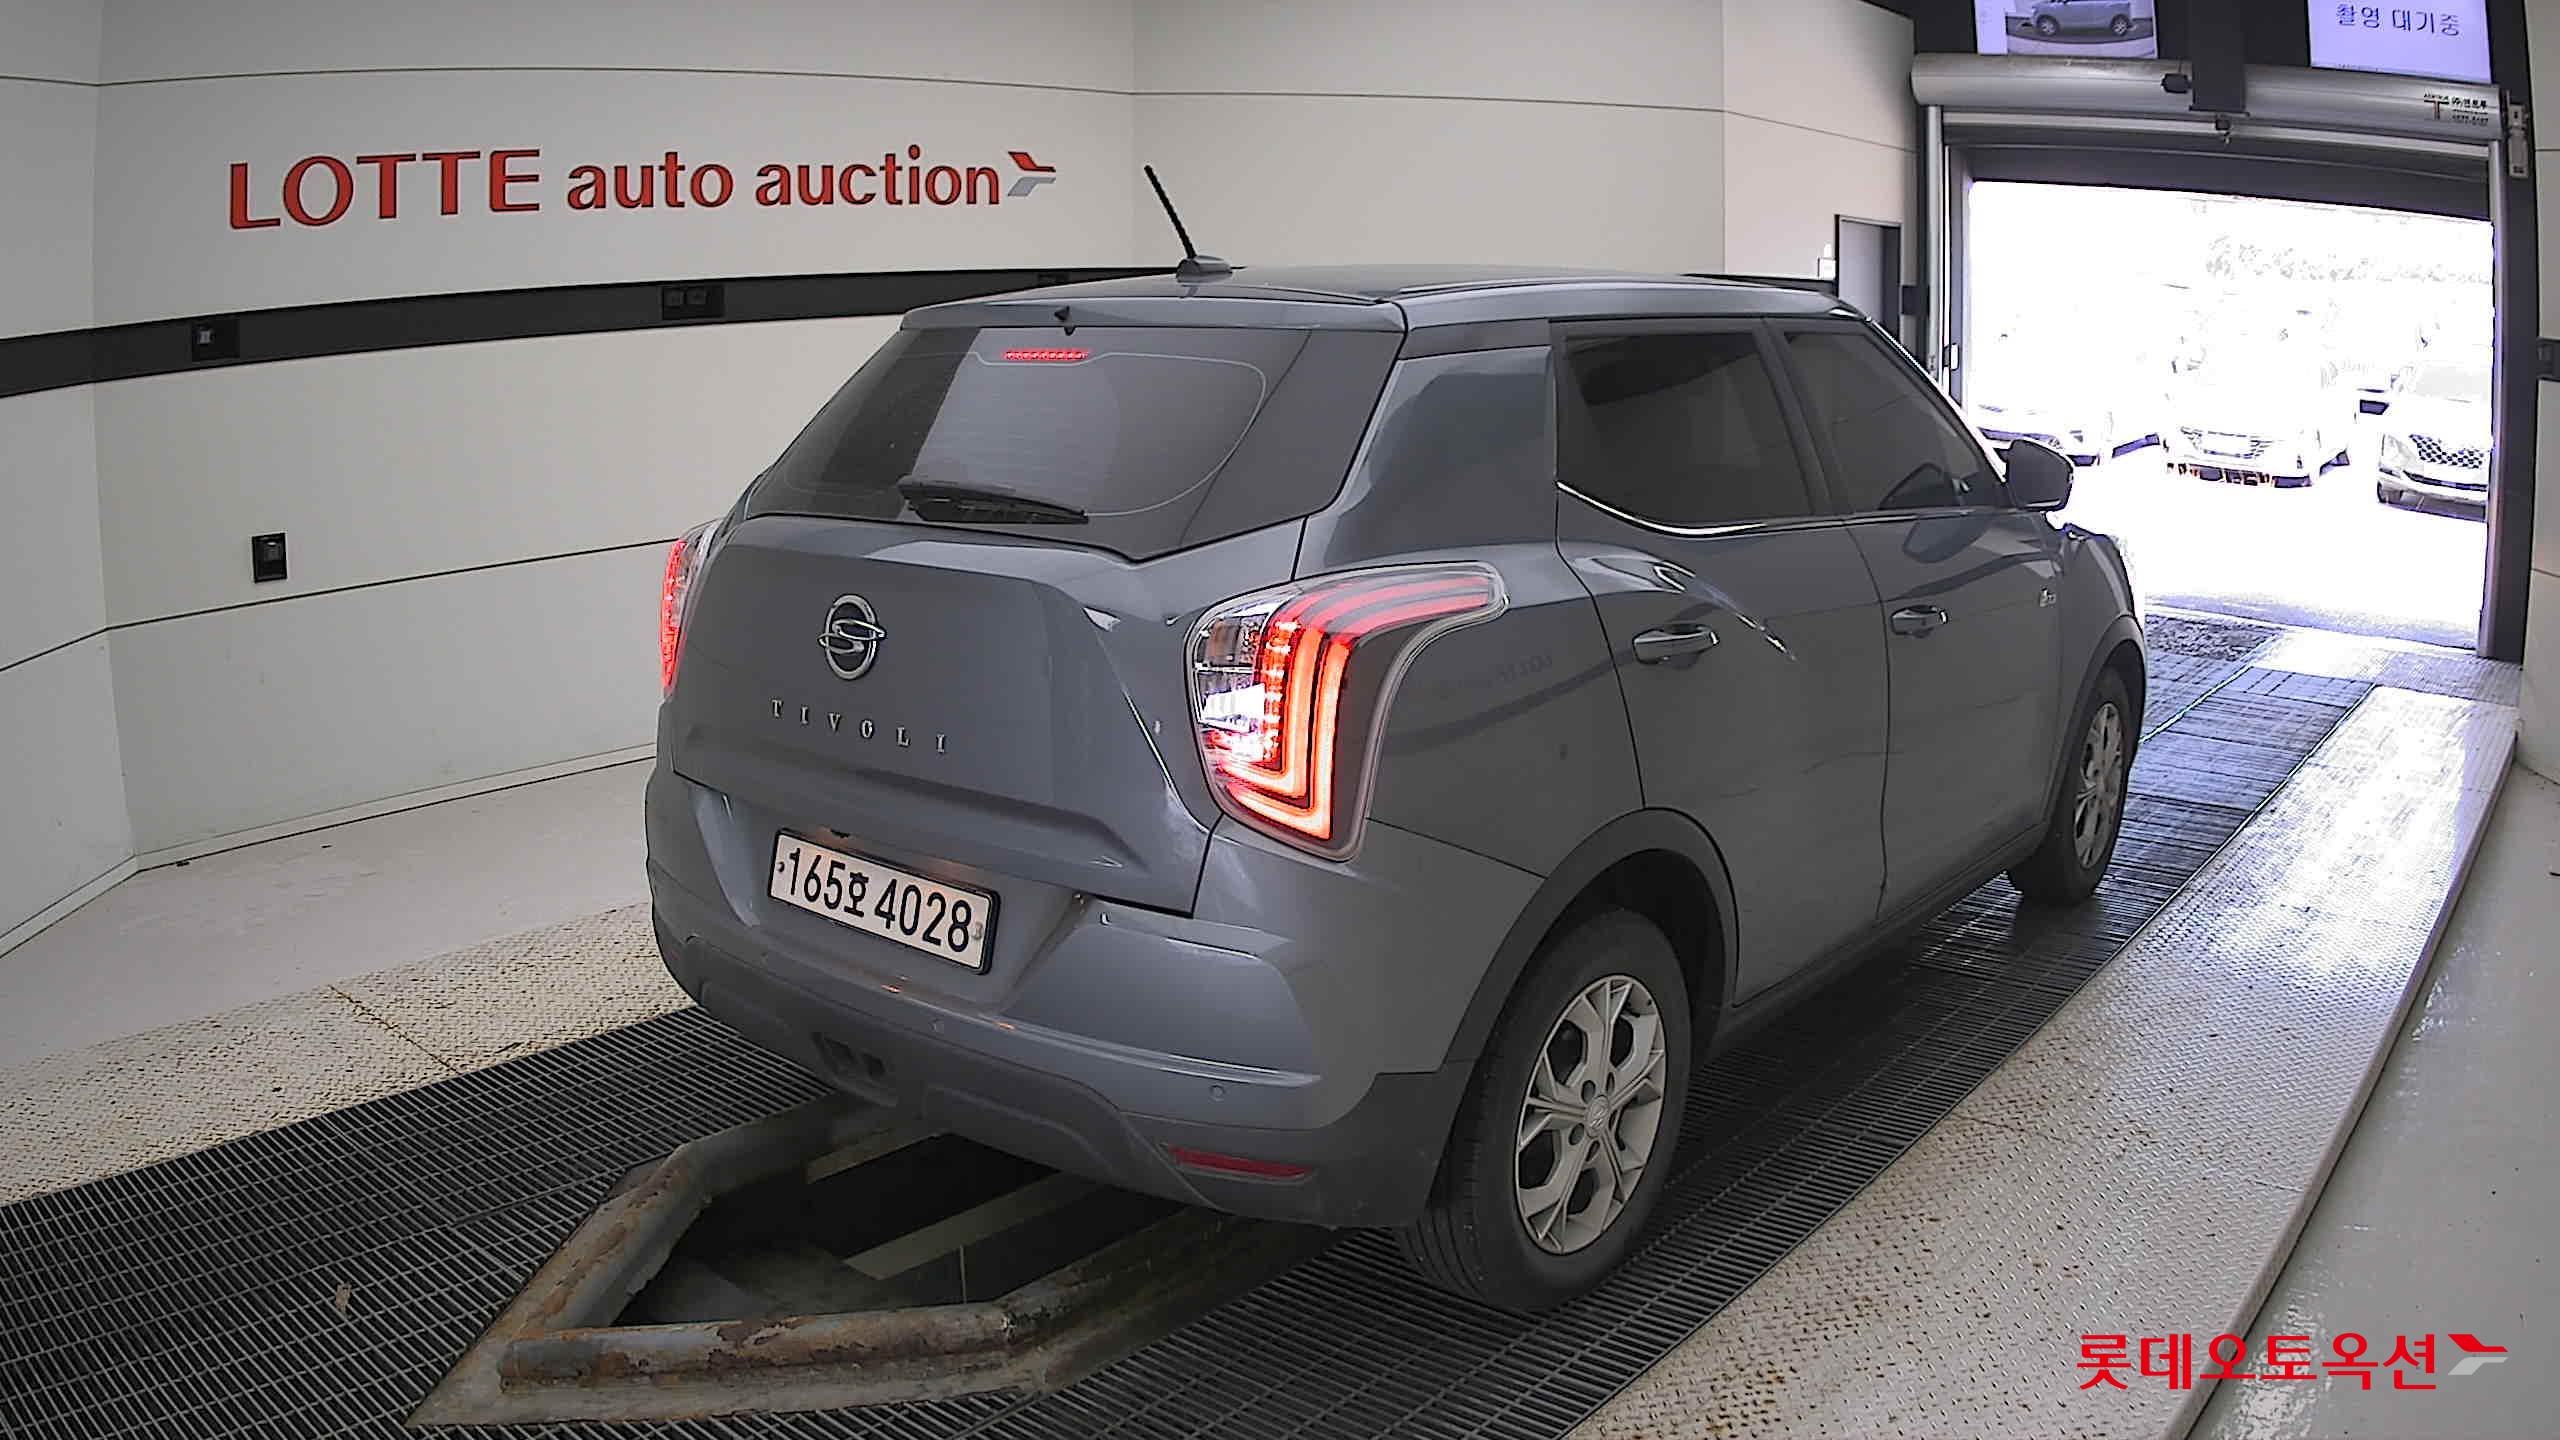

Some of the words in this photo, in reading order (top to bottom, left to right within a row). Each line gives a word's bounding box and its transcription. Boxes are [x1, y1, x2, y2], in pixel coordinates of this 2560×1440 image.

[2336, 4, 2380, 29] 촬영
[2392, 9, 2460, 36] 대기중
[230, 148, 541, 230] LOTTE
[567, 151, 734, 210] auto
[755, 144, 1000, 206] auction
[771, 699, 946, 753] TIVOLI
[789, 848, 869, 918] 165호
[874, 878, 972, 953] 4028
